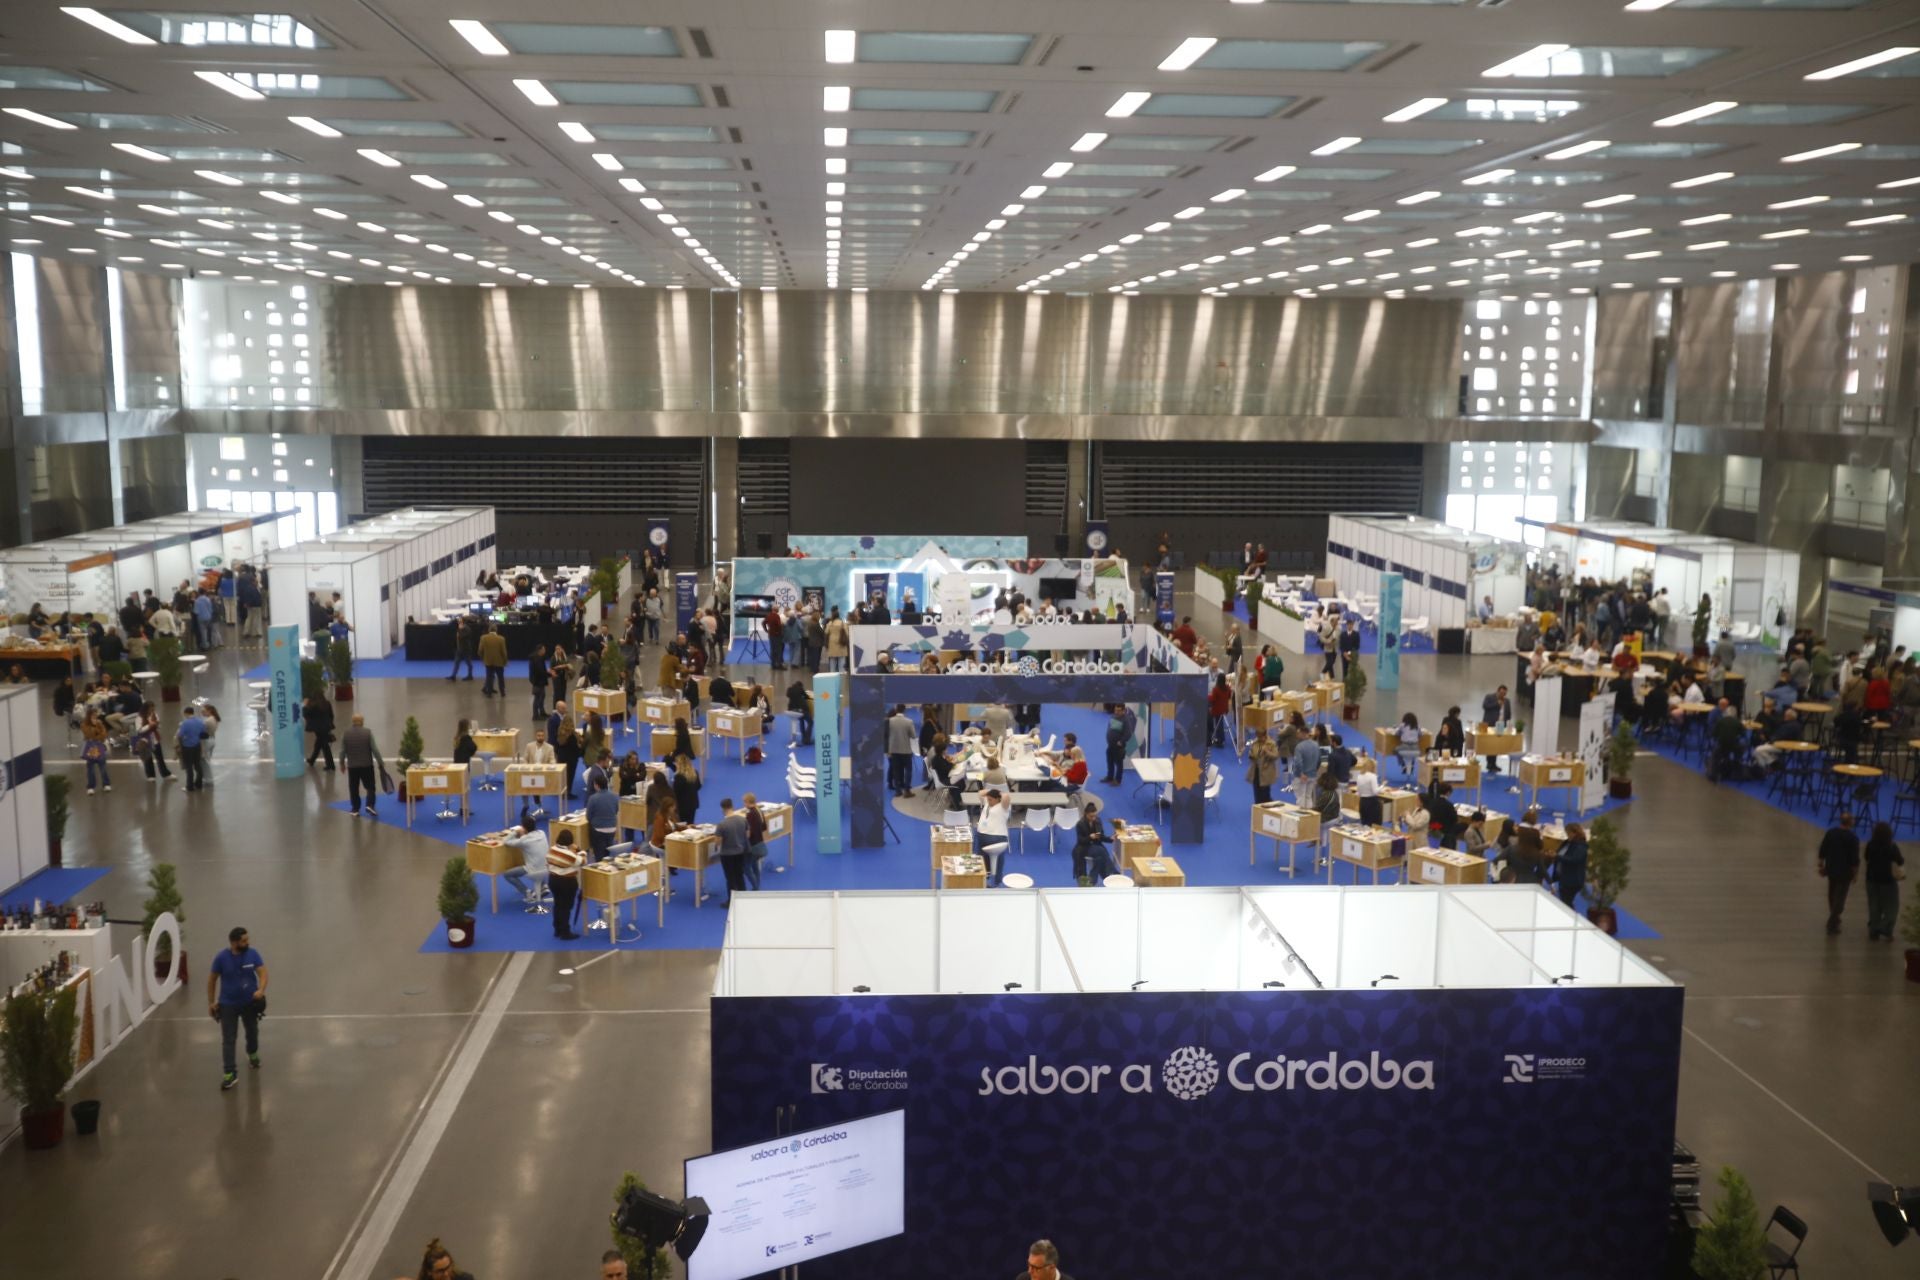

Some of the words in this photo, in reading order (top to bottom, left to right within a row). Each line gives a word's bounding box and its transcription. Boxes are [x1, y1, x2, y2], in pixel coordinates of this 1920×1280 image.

[821, 734, 833, 798] TALLERES
[1538, 1058, 1586, 1066] IPRODECO
[848, 1069, 908, 1080] Diputación
[979, 1055, 1110, 1096] sabor
[1120, 1064, 1152, 1093] a
[848, 1082, 861, 1090] de
